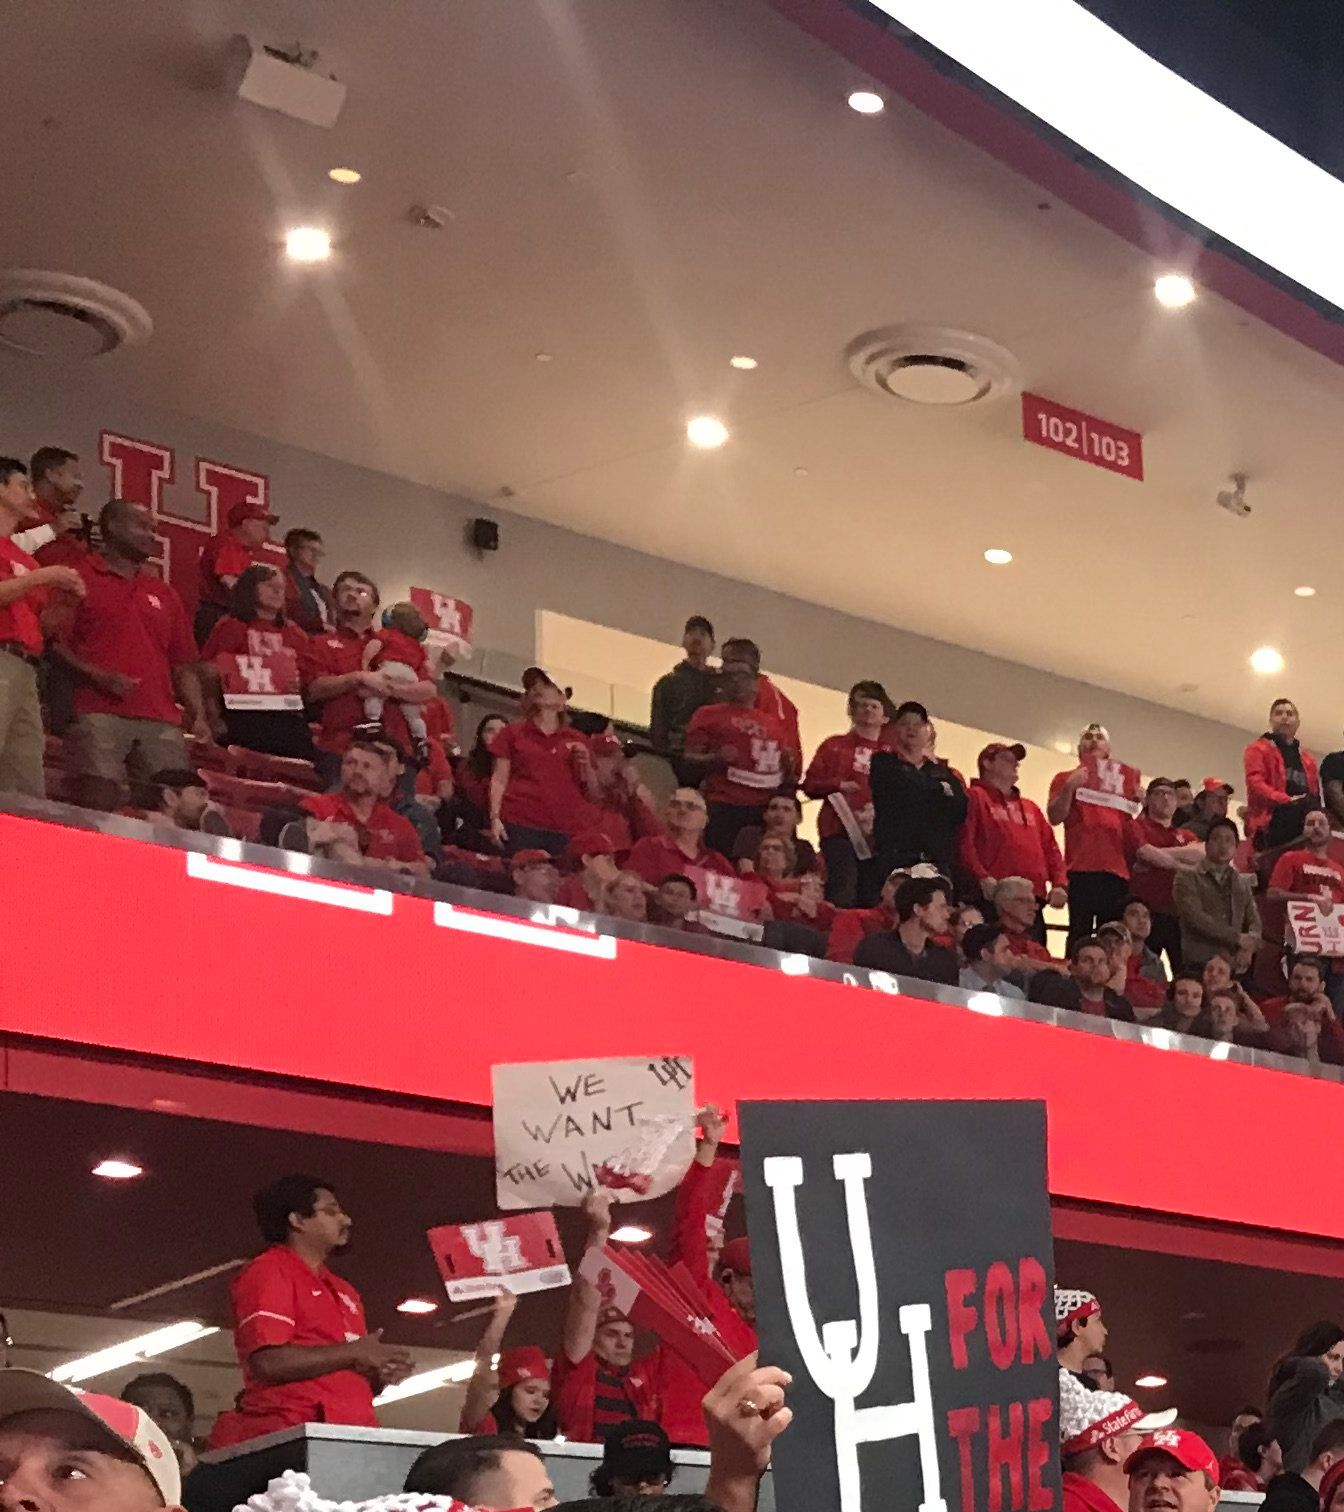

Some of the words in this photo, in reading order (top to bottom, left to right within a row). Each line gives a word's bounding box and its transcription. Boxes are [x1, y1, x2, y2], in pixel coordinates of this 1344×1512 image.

[549, 1073, 605, 1105] WE
[521, 1101, 644, 1144] WANT
[503, 1159, 550, 1185] THE
[459, 1220, 532, 1275] UH
[944, 1255, 1052, 1371] FOR
